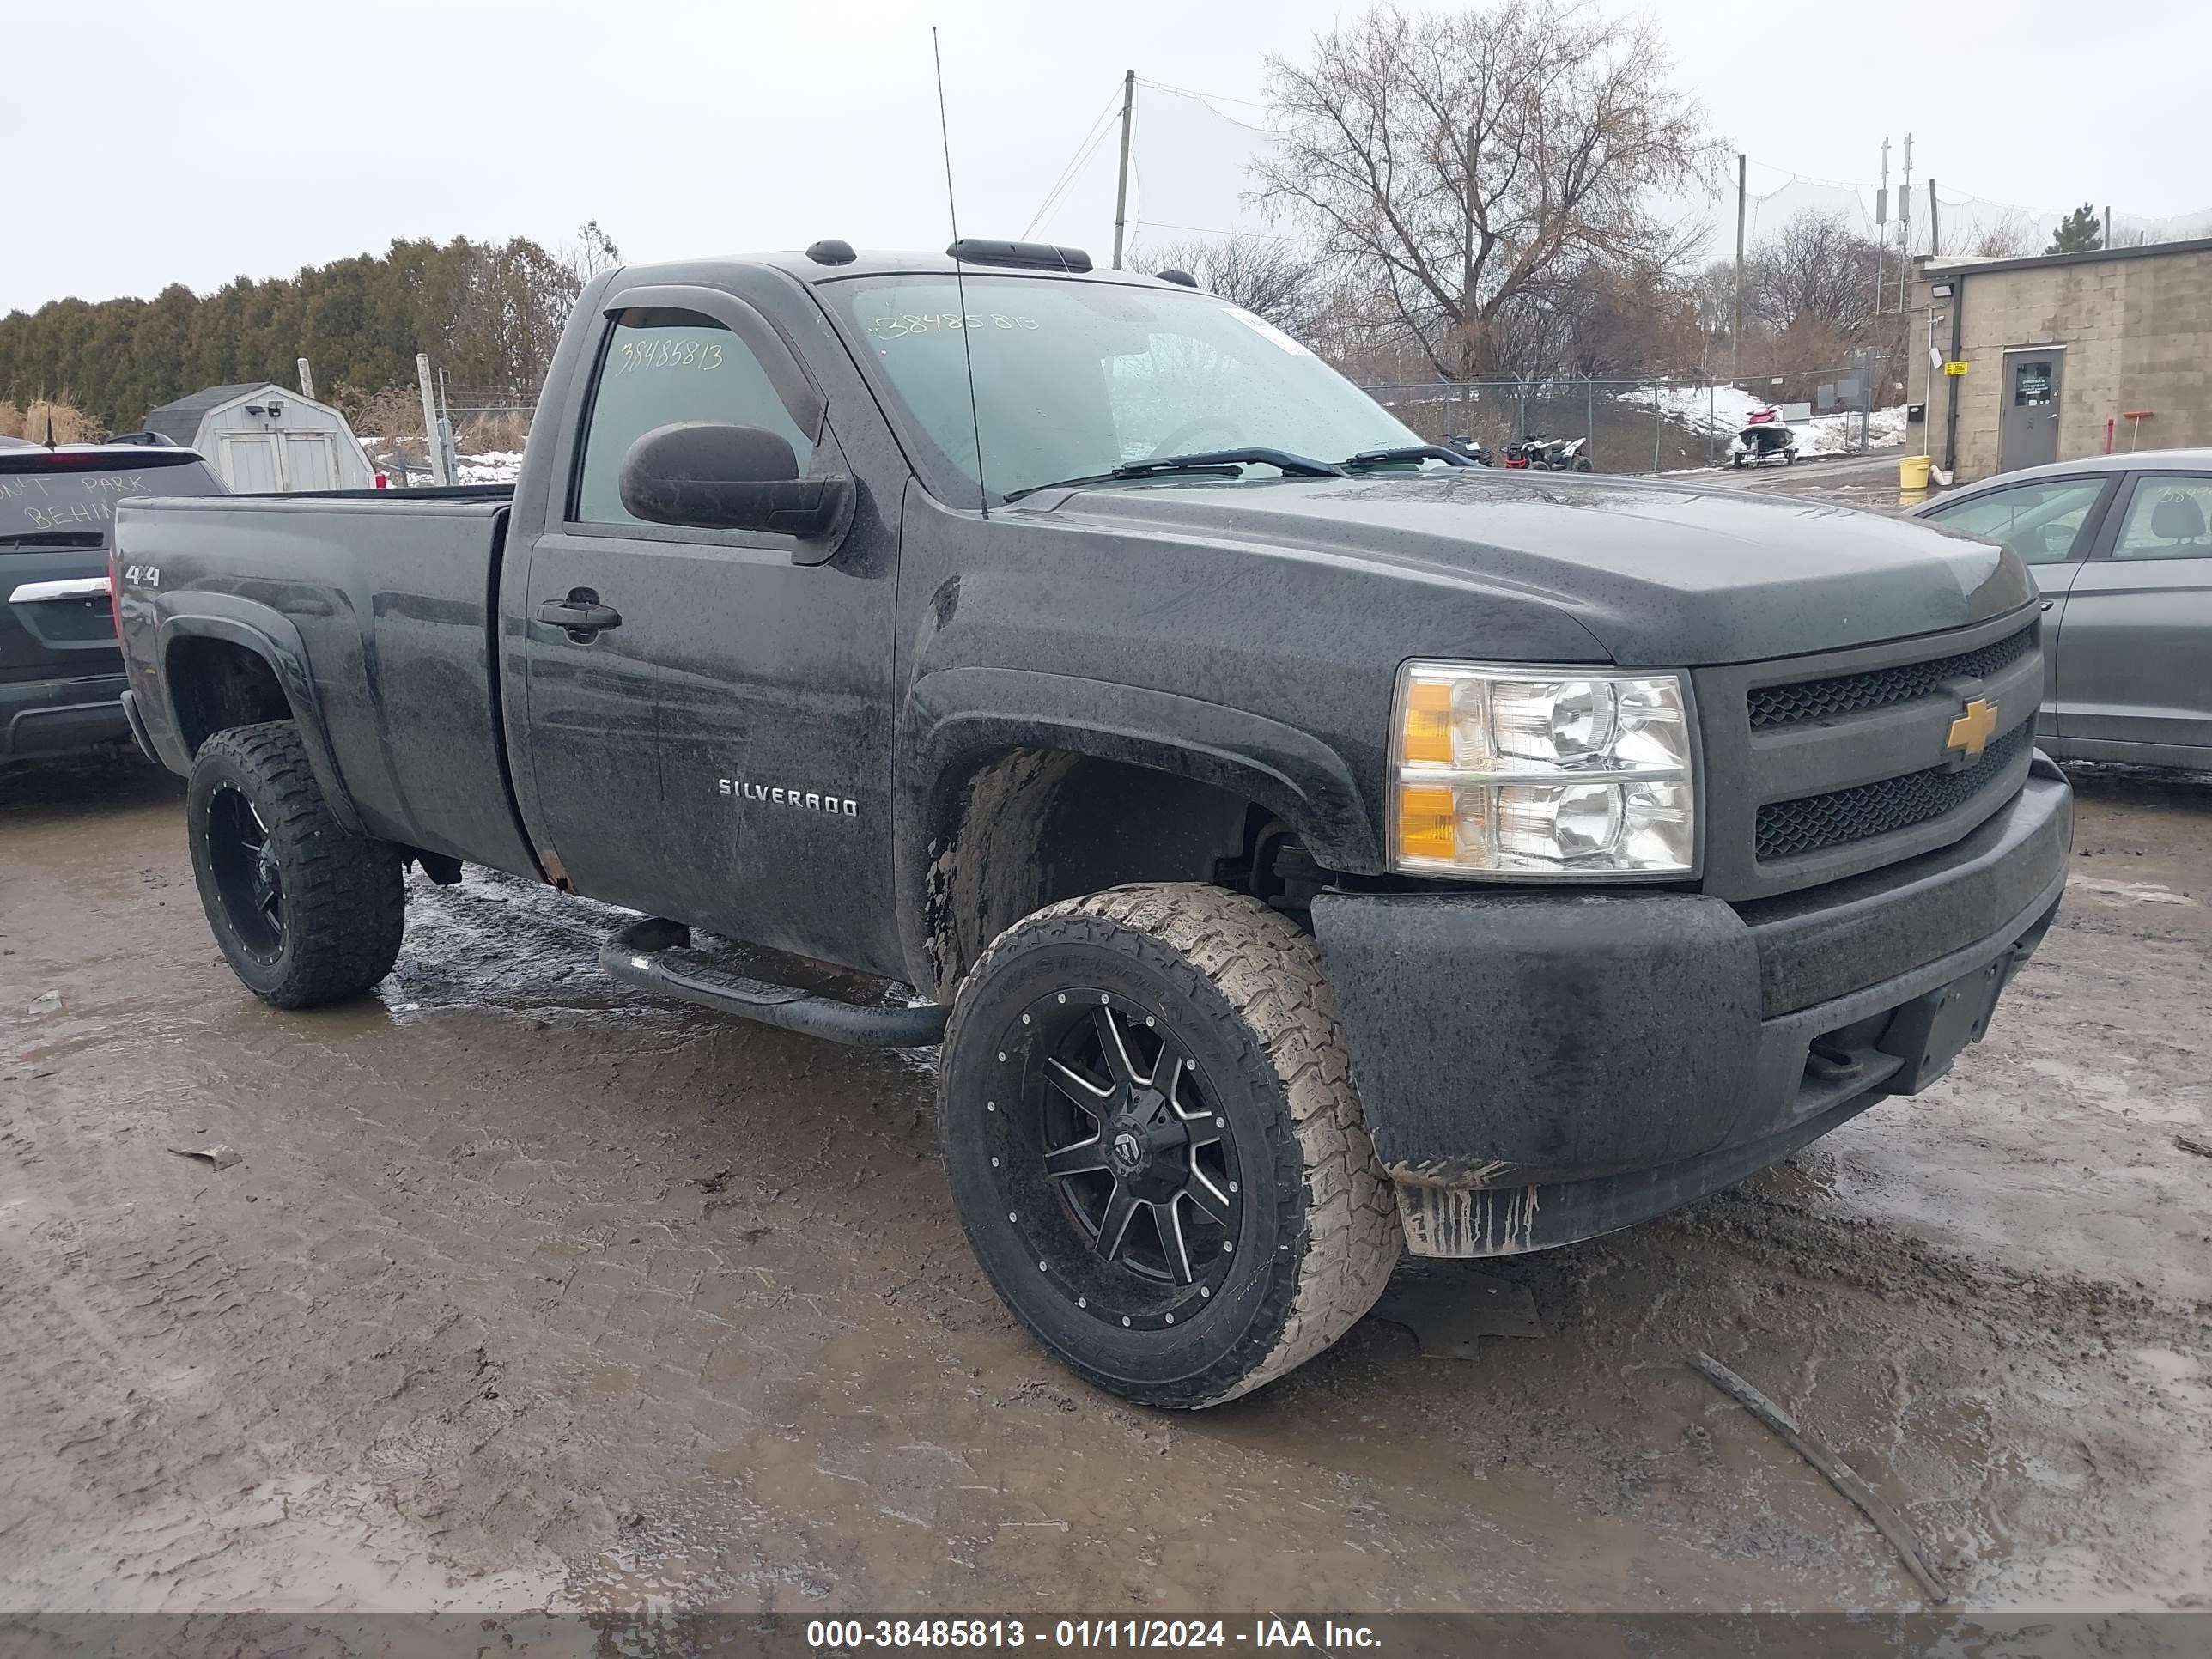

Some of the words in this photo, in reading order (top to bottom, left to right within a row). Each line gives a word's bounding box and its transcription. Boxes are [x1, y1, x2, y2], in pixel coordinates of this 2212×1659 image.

[615, 338, 724, 377] 38485813
[82, 476, 152, 495] PARK
[718, 778, 858, 817] SILVERADO
